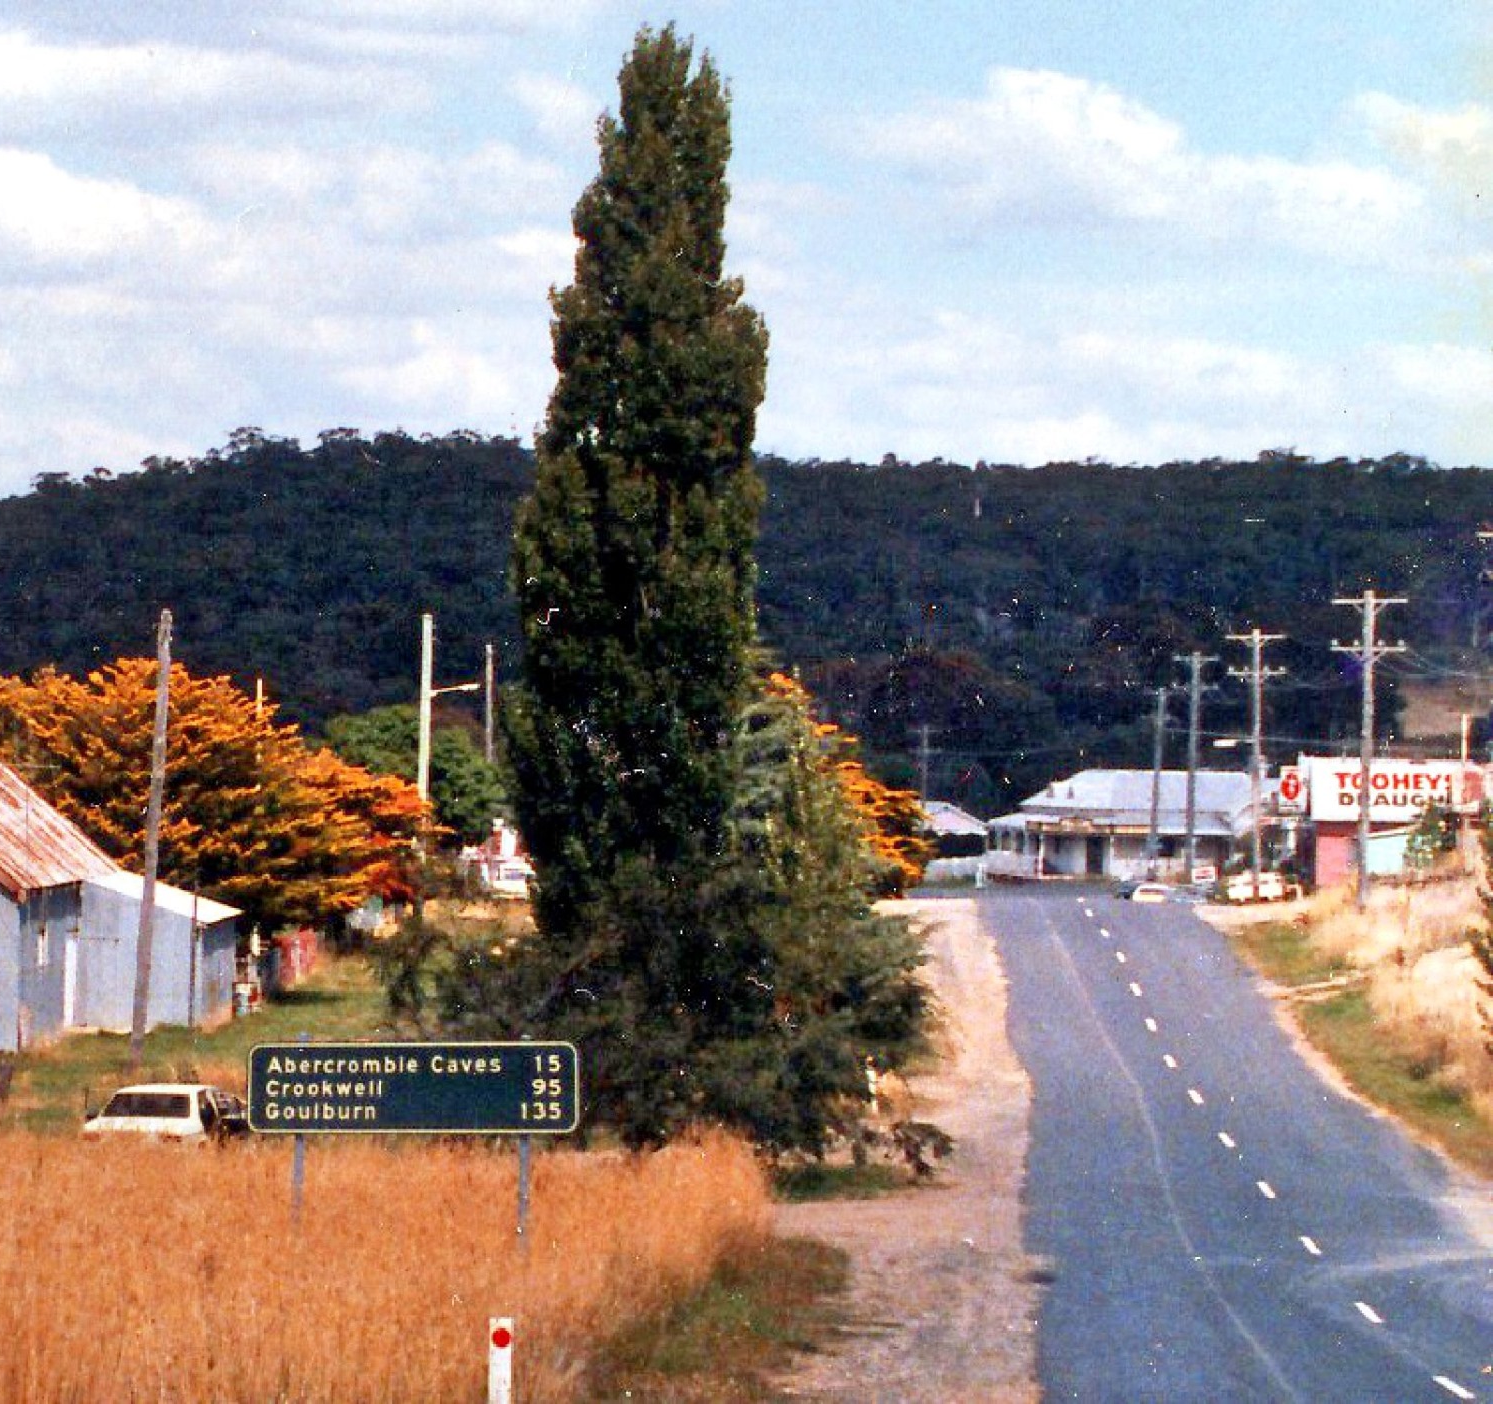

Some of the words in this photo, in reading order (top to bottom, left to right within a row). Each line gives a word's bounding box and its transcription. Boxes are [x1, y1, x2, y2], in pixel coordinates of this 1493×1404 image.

[267, 1055, 418, 1074] Abercrombie
[431, 1054, 502, 1074] Caves
[535, 1054, 562, 1073] 15
[265, 1080, 383, 1098] Crookwell
[531, 1078, 562, 1096] 95
[265, 1102, 377, 1120] Goulburn
[521, 1102, 562, 1120] 135
